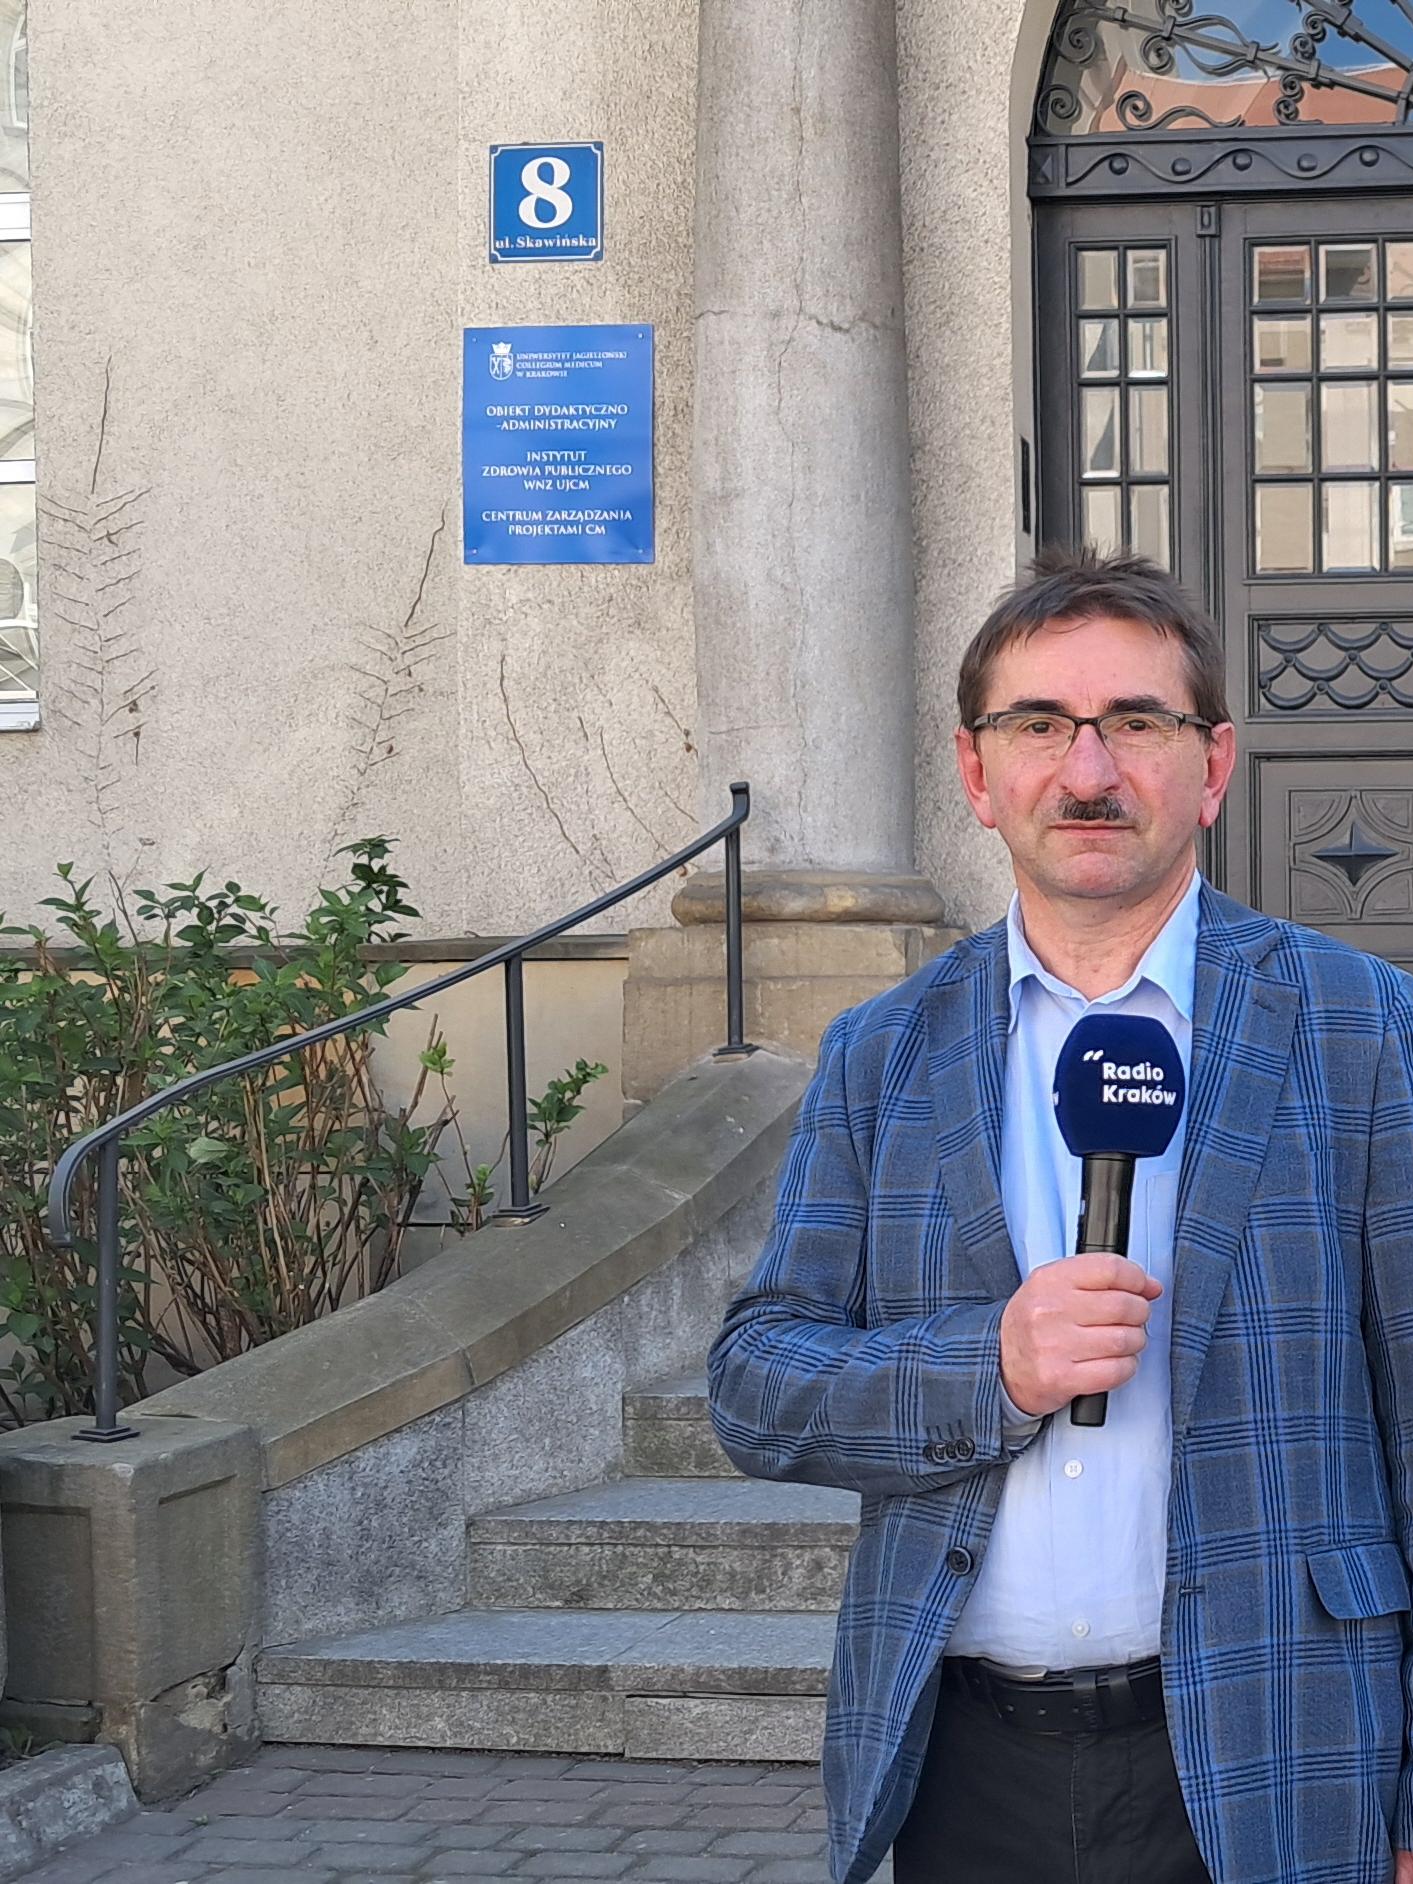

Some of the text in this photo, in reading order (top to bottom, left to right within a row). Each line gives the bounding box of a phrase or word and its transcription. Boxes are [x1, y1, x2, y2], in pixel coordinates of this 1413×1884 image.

[518, 156, 573, 229] 8
[495, 234, 596, 249] ul. Skawińska
[516, 361, 562, 369] COLLEGIUM
[486, 404, 628, 416] OBIEKT DYDAKTYCZNO
[496, 418, 617, 431] -ADMINISTRACYJNY
[526, 451, 587, 462] INSTYTUT
[482, 464, 632, 477] ZDROWIA PUBLICZNEGO
[523, 479, 553, 490] WNZ
[482, 510, 633, 522] CENTRUM ZARZĄDZANIA
[508, 524, 606, 537] PROJEKTAMI CM
[1102, 1061, 1164, 1081] Radio
[1102, 1084, 1177, 1106] Kraków
